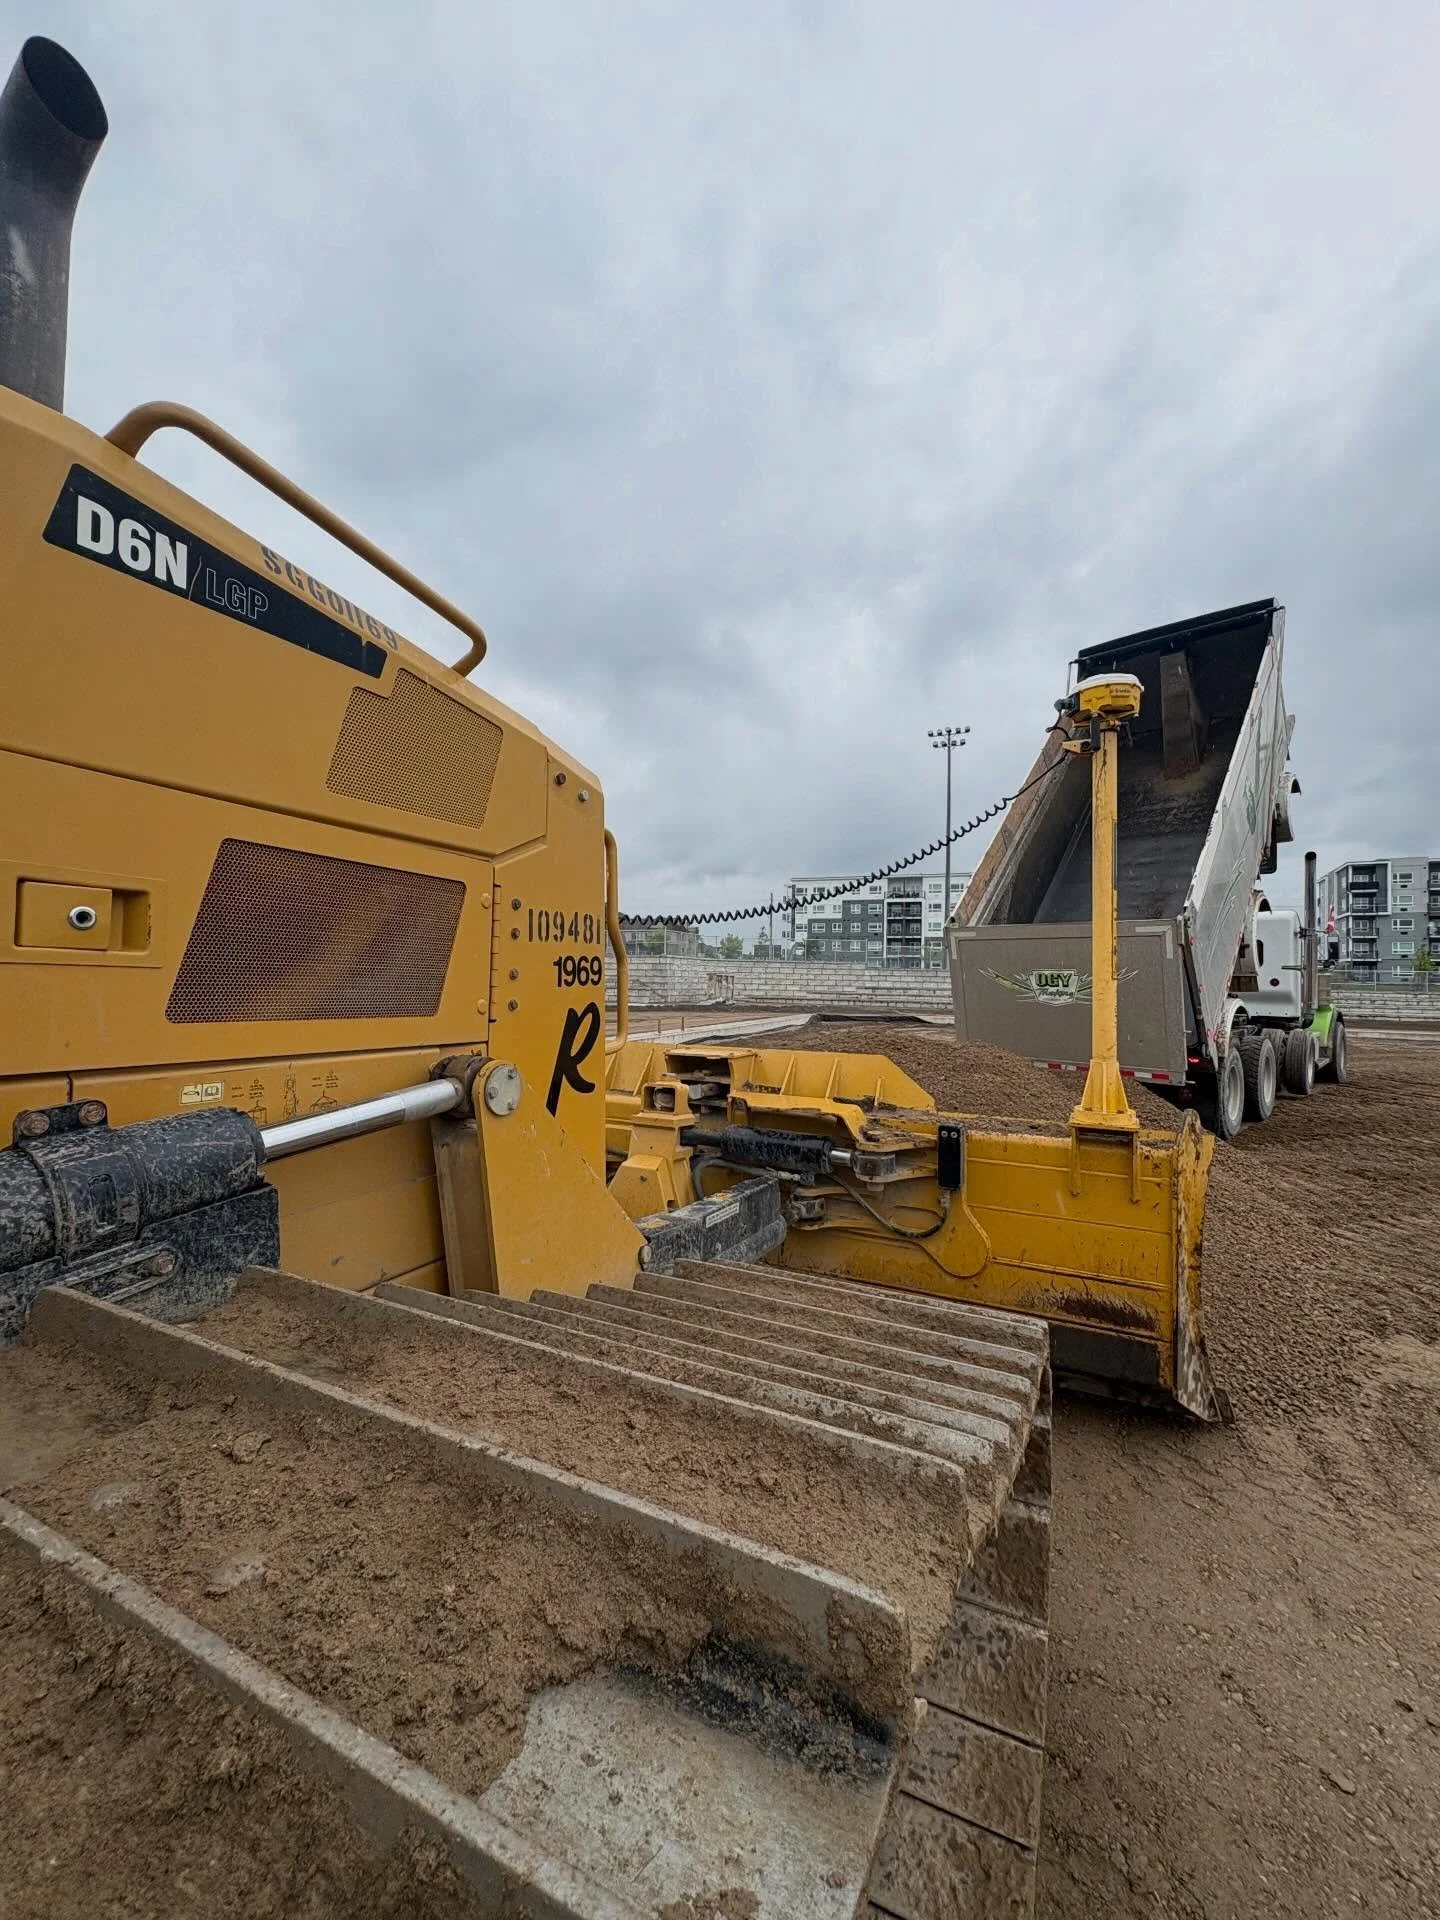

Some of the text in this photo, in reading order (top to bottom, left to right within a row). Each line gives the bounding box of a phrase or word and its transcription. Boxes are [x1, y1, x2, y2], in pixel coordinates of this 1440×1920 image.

[76, 494, 269, 620] D6N LGP
[553, 955, 602, 988] 1969
[545, 1001, 601, 1118] R
